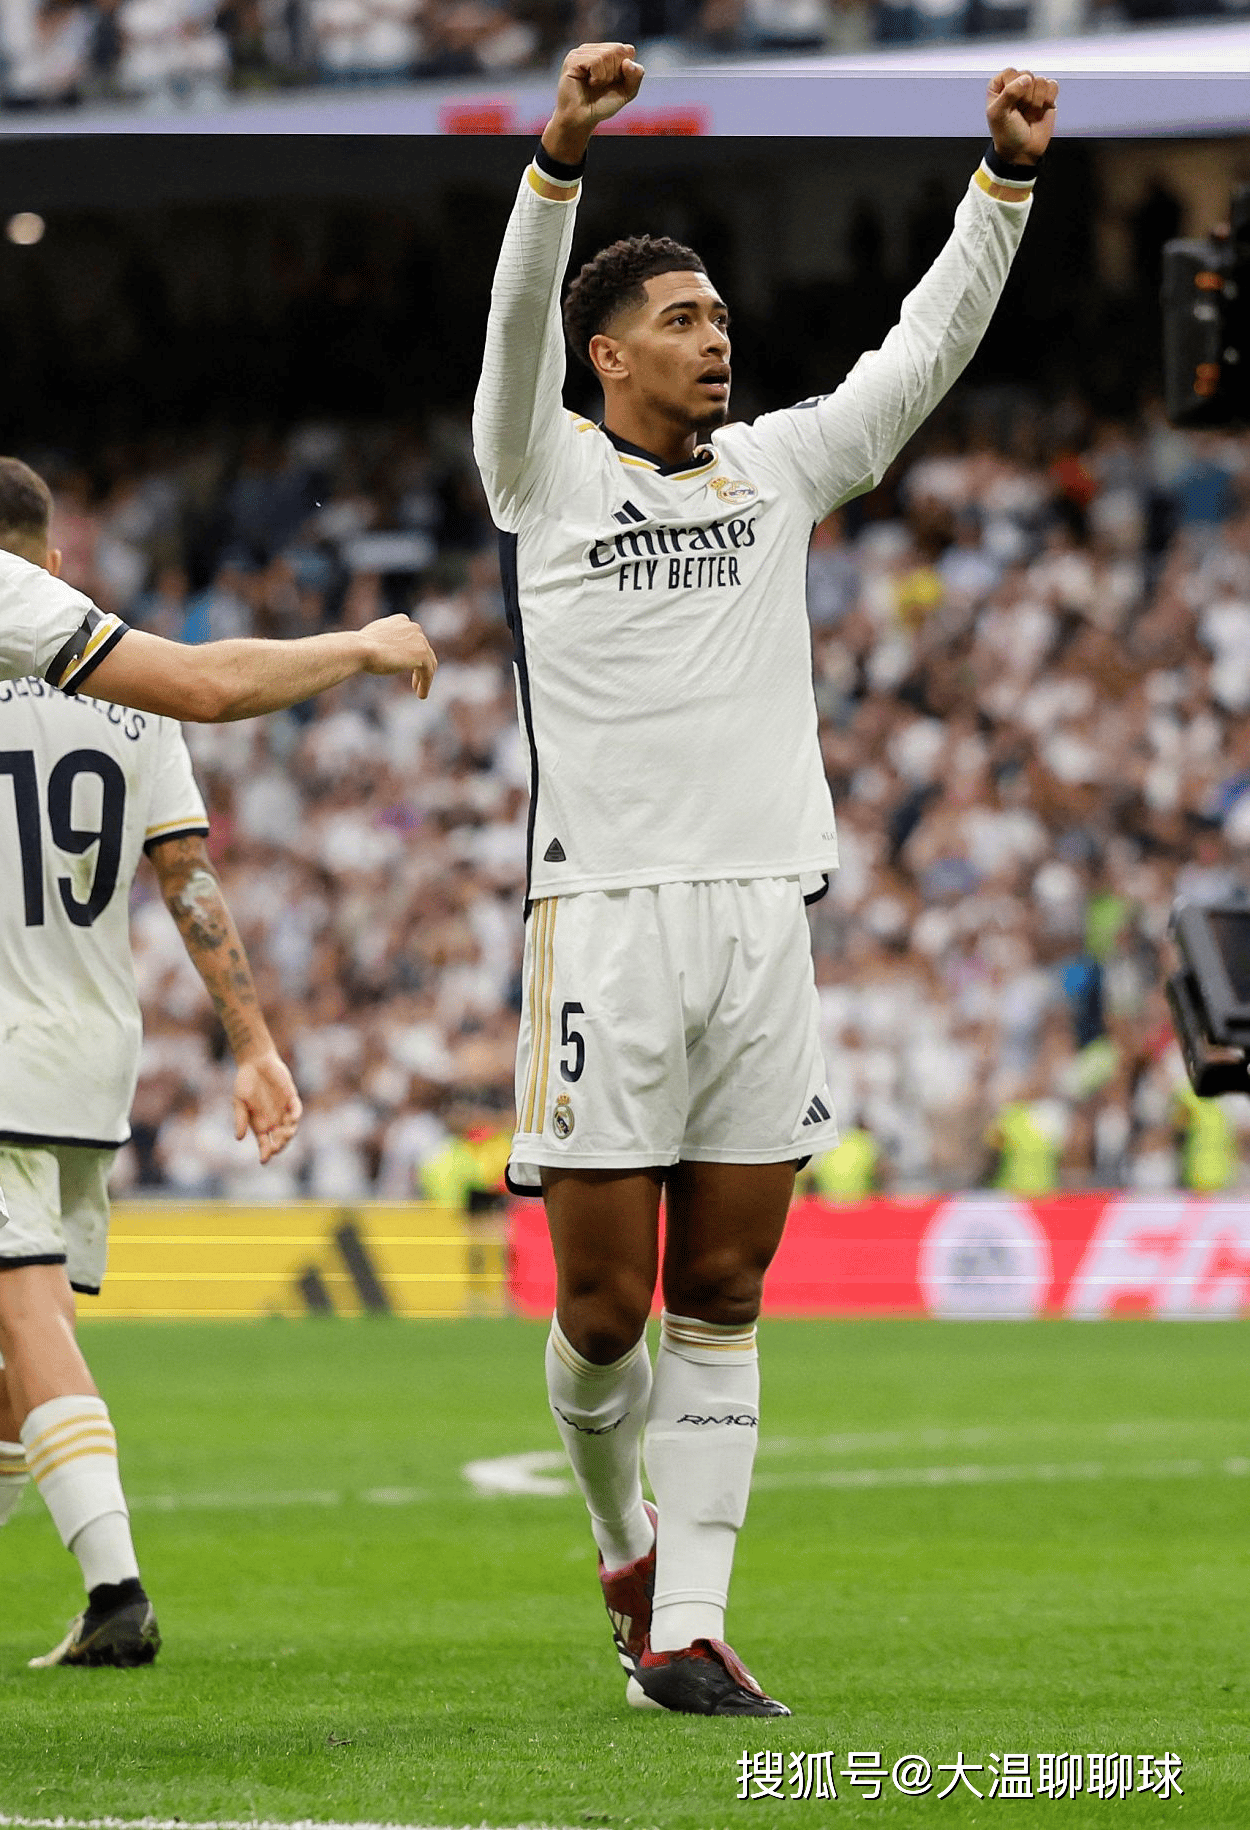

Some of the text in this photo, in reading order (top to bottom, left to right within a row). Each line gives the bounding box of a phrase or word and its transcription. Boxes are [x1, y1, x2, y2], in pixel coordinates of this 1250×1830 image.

[618, 556, 742, 591] FLY BETTER
[560, 1001, 586, 1082] 5
